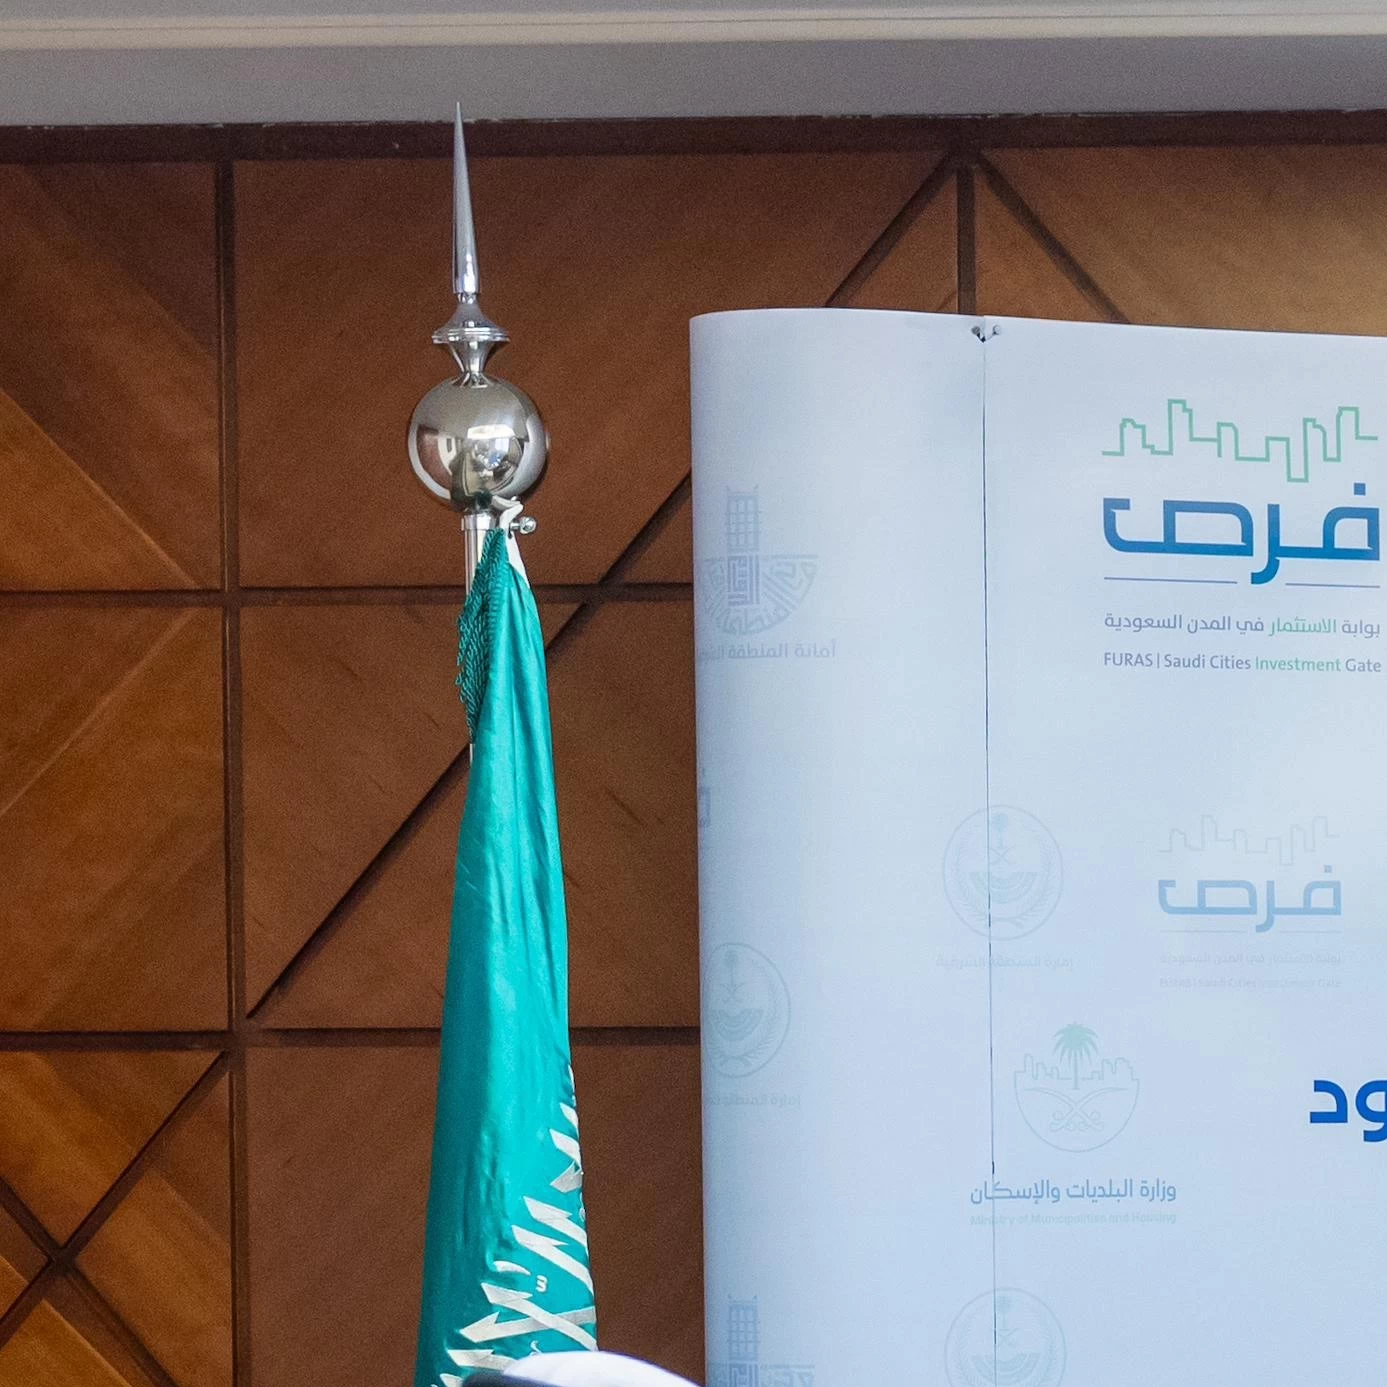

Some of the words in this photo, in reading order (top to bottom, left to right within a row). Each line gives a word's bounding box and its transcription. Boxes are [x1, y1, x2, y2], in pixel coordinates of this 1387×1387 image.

[1102, 482, 1381, 585] فرص
[1103, 613, 1183, 632] السعودية
[1187, 616, 1231, 633] المدن
[1236, 617, 1265, 635] في
[1268, 617, 1337, 637] الاستثمار
[1341, 619, 1381, 638] بوابة
[794, 638, 836, 659] أمانة
[1103, 652, 1153, 667] FURAS
[1163, 653, 1206, 669] Saudi
[1209, 655, 1252, 670] Cities
[1254, 656, 1342, 672] Investment
[1345, 658, 1382, 673] Gate
[1158, 865, 1342, 933] فرص
[970, 1180, 1061, 1205] والإسكان
[1066, 1178, 1133, 1203] البلديات
[1139, 1178, 1177, 1202] وزارة
